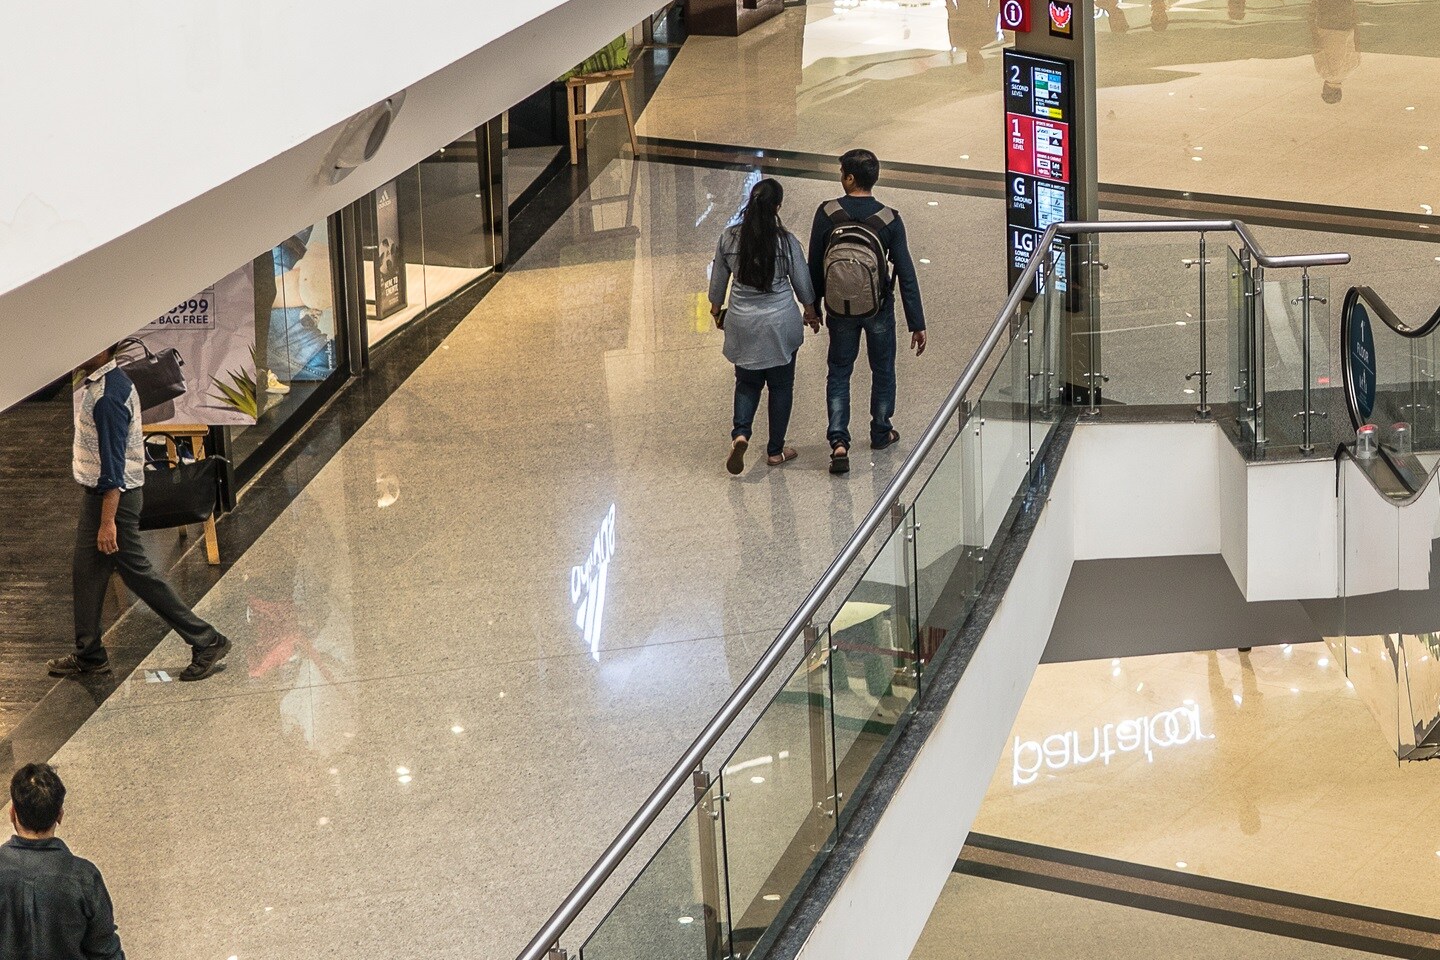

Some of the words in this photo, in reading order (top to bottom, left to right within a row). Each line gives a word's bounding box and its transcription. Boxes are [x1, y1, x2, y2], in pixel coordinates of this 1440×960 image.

[1011, 65, 1020, 83] 2
[1011, 83, 1029, 92] SECOND
[1011, 118, 1021, 137] 1
[1013, 143, 1024, 151] LEVEL
[1014, 177, 1025, 195] G
[1014, 195, 1033, 204] GROUND
[1014, 201, 1025, 209] LEVEL
[1014, 230, 1033, 252] LG
[1015, 256, 1029, 264] GROUN
[159, 315, 180, 325] BAG
[183, 315, 209, 325] FREE
